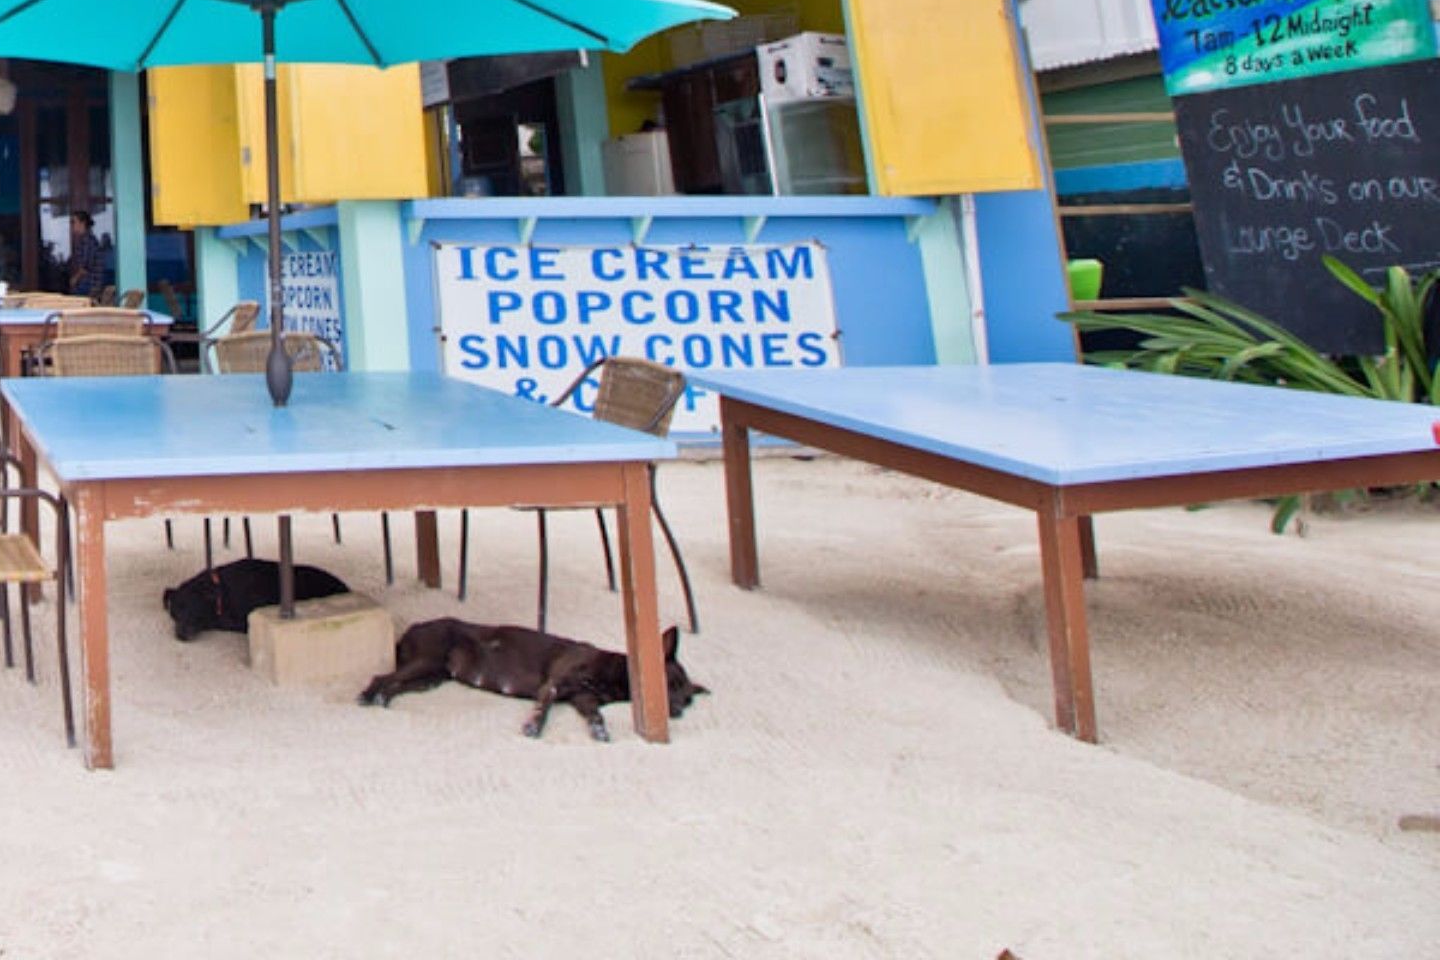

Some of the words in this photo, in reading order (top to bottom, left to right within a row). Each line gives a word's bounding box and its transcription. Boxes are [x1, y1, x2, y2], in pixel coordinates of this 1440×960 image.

[1287, 3, 1375, 38] Midnight
[1225, 55, 1237, 75] 8
[1242, 52, 1283, 73] days
[1291, 48, 1304, 64] a
[1209, 107, 1285, 161] Enjoy
[1247, 167, 1338, 205] Drinks
[1348, 178, 1383, 201] on
[1315, 217, 1402, 253] Deck
[456, 246, 566, 281] ICE
[591, 245, 814, 281] CREAM
[281, 284, 332, 309] OPCORN
[487, 289, 790, 326] POPCORN
[458, 333, 621, 369] SNOW
[645, 331, 828, 368] CONES
